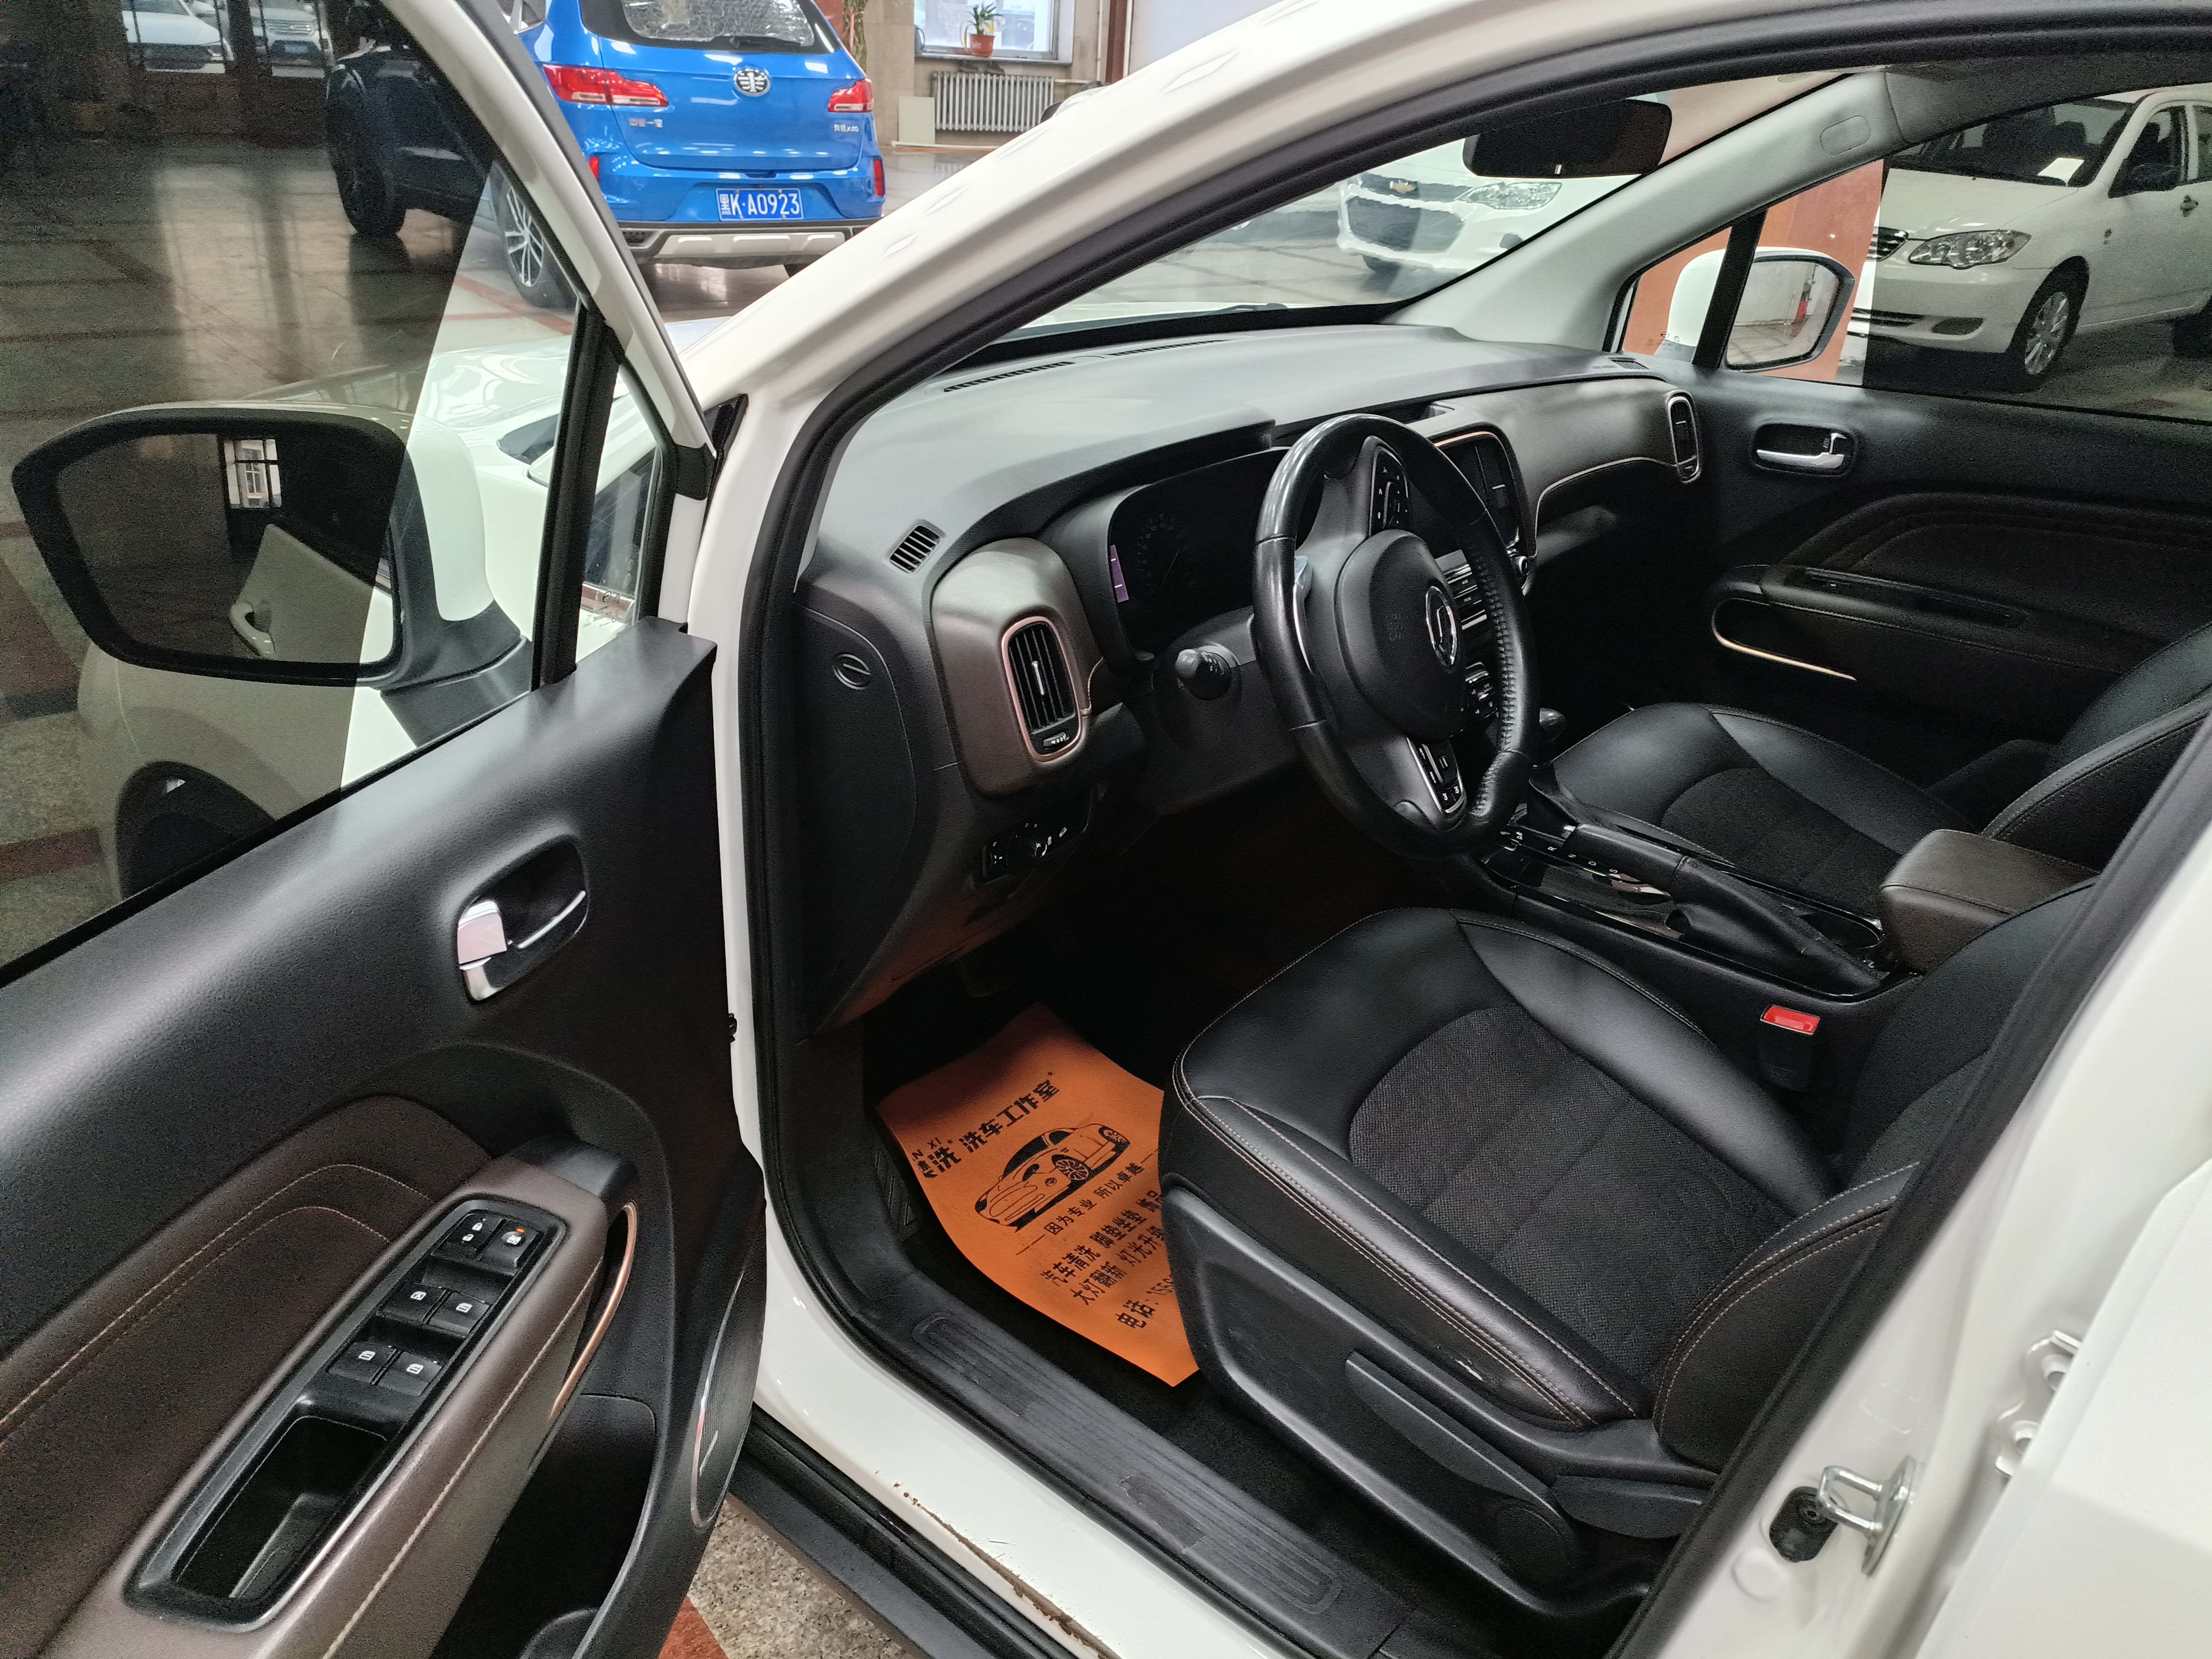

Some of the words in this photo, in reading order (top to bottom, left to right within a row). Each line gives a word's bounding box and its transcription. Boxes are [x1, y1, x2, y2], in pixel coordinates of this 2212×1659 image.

[958, 1080, 1060, 1153] 洗车工作室
[1044, 1199, 1097, 1235] 因为专业
[1094, 1162, 1145, 1199] 所以卓越
[1040, 1245, 1101, 1287] 汽车清洗
[1090, 1210, 1147, 1249] 脚垫坐垫
[1070, 1261, 1128, 1305] 大灯翻新
